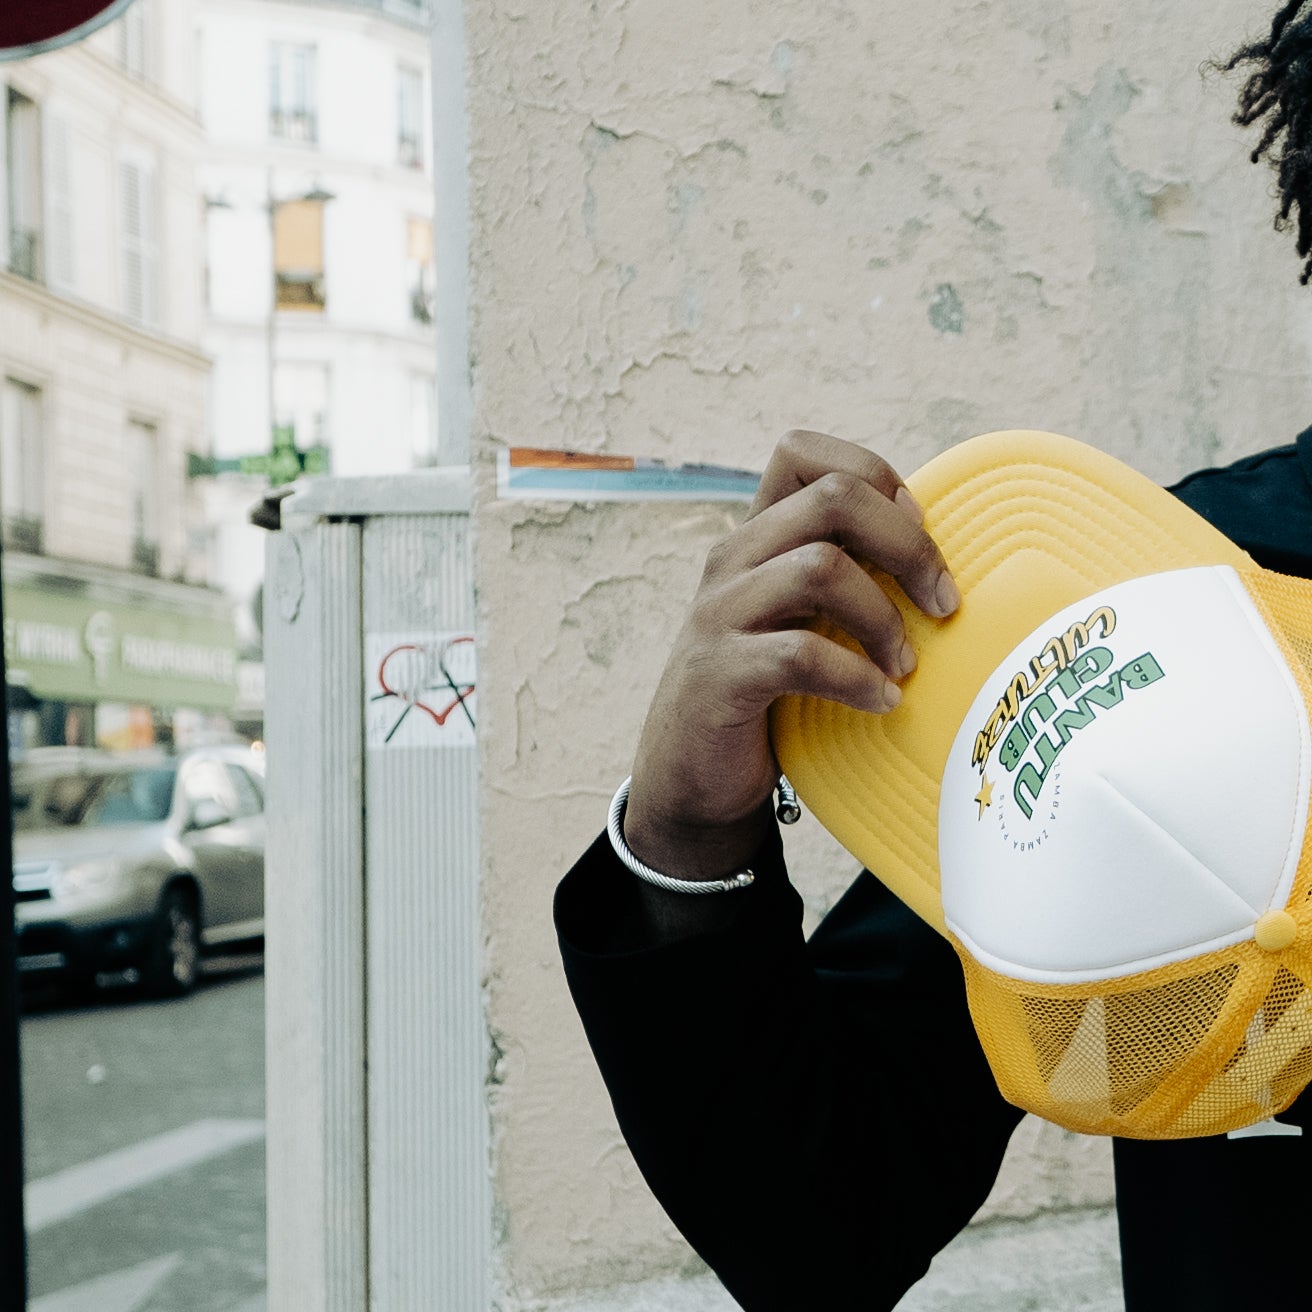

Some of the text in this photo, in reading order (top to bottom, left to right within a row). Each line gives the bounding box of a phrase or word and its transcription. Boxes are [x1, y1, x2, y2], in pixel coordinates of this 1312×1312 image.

[971, 605, 1117, 776] CULTURE
[998, 645, 1114, 773] CLUB
[1013, 651, 1166, 821] BANTU
